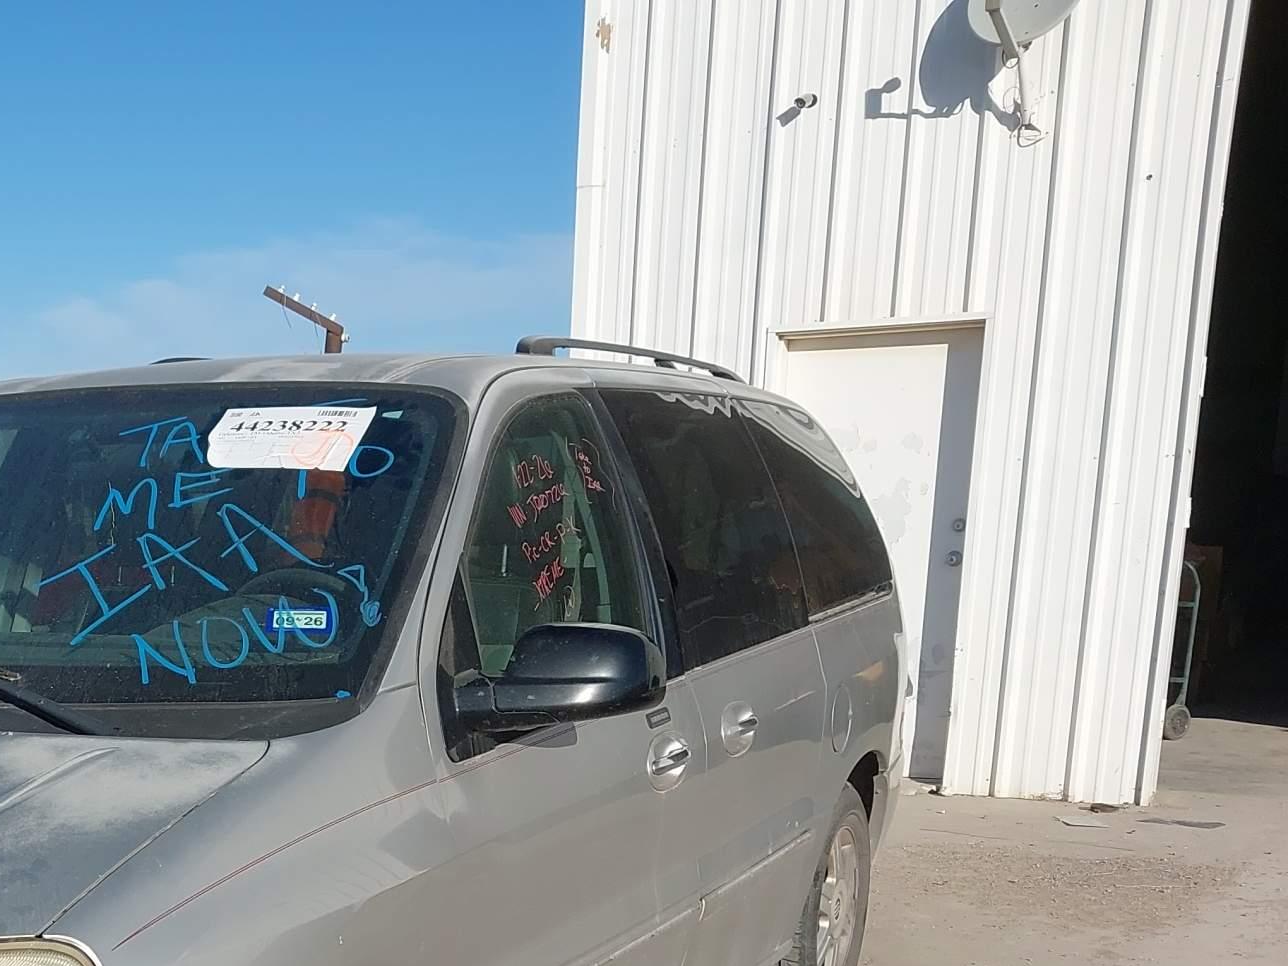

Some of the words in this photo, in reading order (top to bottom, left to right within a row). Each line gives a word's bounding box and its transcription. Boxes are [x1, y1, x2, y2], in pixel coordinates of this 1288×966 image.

[229, 420, 348, 432] 44238222
[94, 468, 234, 531] ME
[38, 503, 335, 645] IAA
[304, 616, 323, 626] 26
